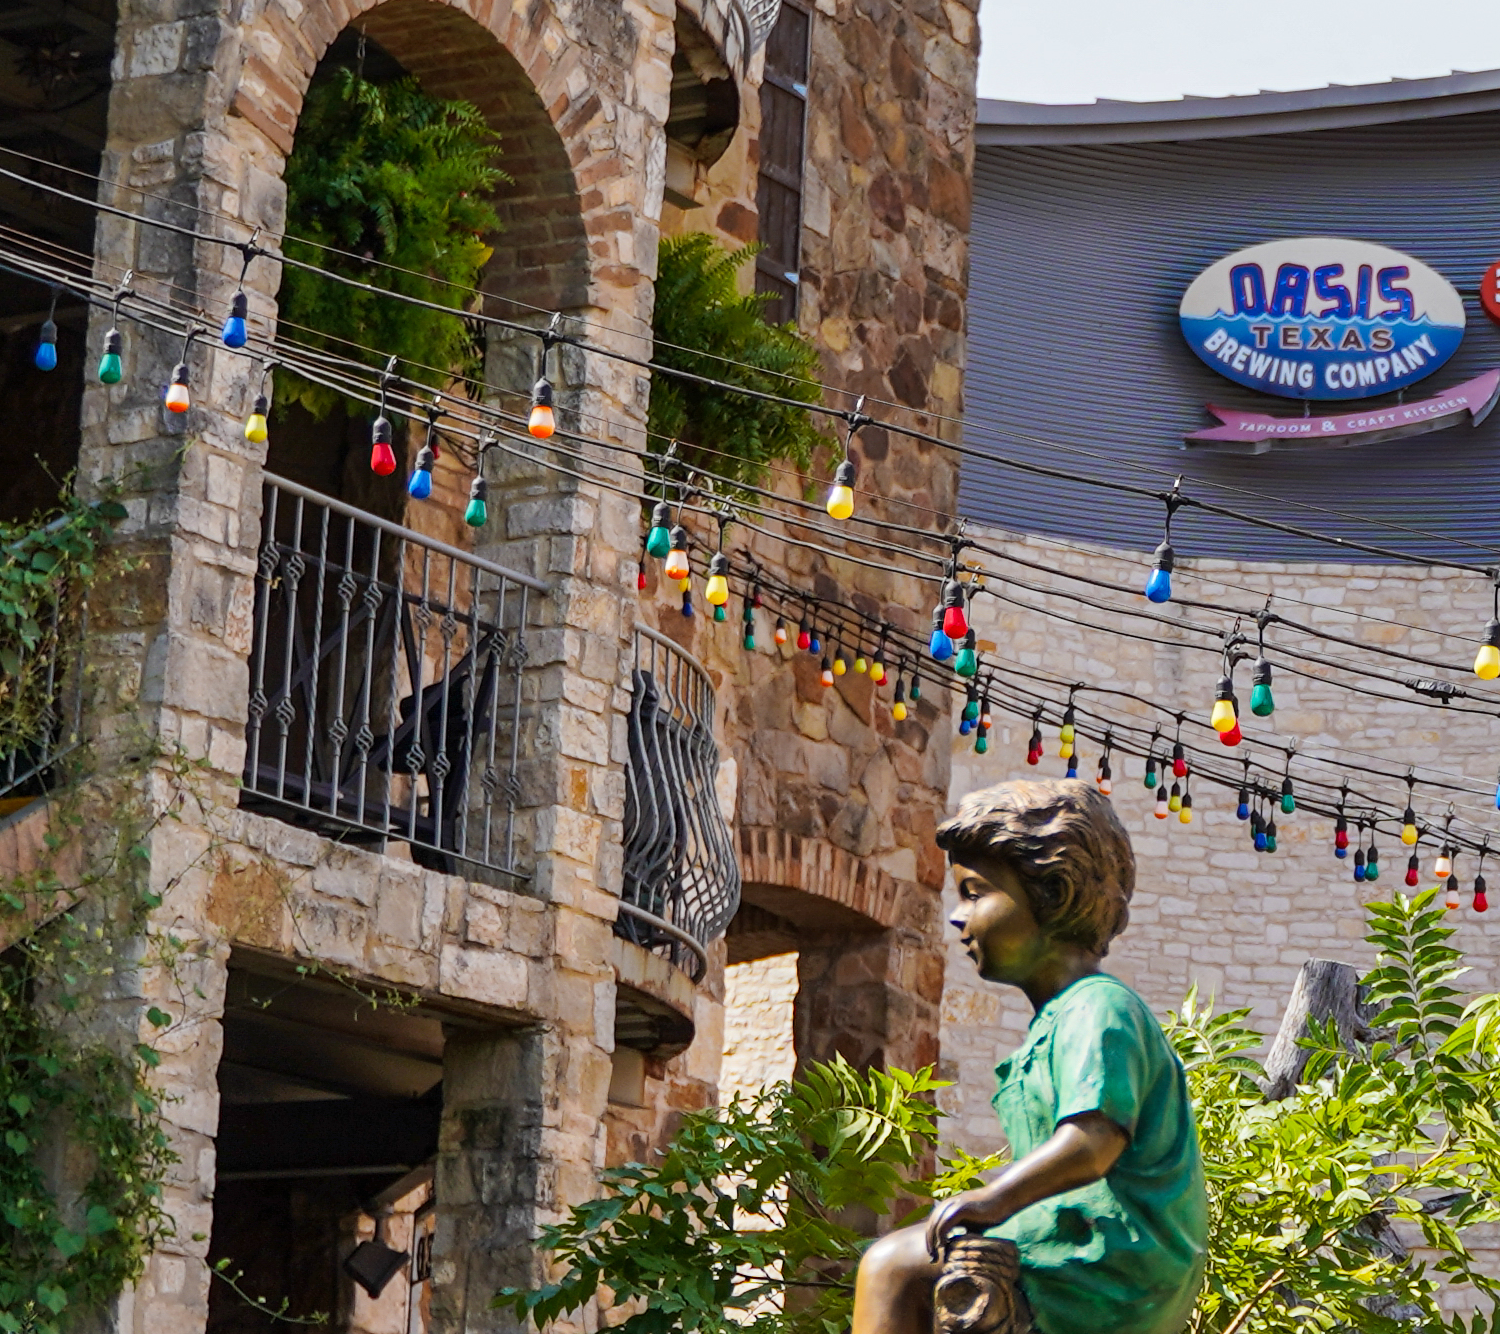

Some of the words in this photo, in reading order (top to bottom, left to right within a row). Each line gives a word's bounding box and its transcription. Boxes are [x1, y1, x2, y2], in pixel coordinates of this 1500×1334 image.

[1229, 262, 1416, 320] OASIS
[1203, 327, 1314, 389] BREWING
[1324, 333, 1438, 390] COMPANY
[1250, 325, 1395, 352] TEXAS
[1239, 421, 1312, 434] TAPROOM
[1321, 421, 1337, 433] &
[1347, 414, 1395, 430] CRAFT
[1403, 395, 1469, 420] KITCHEN
